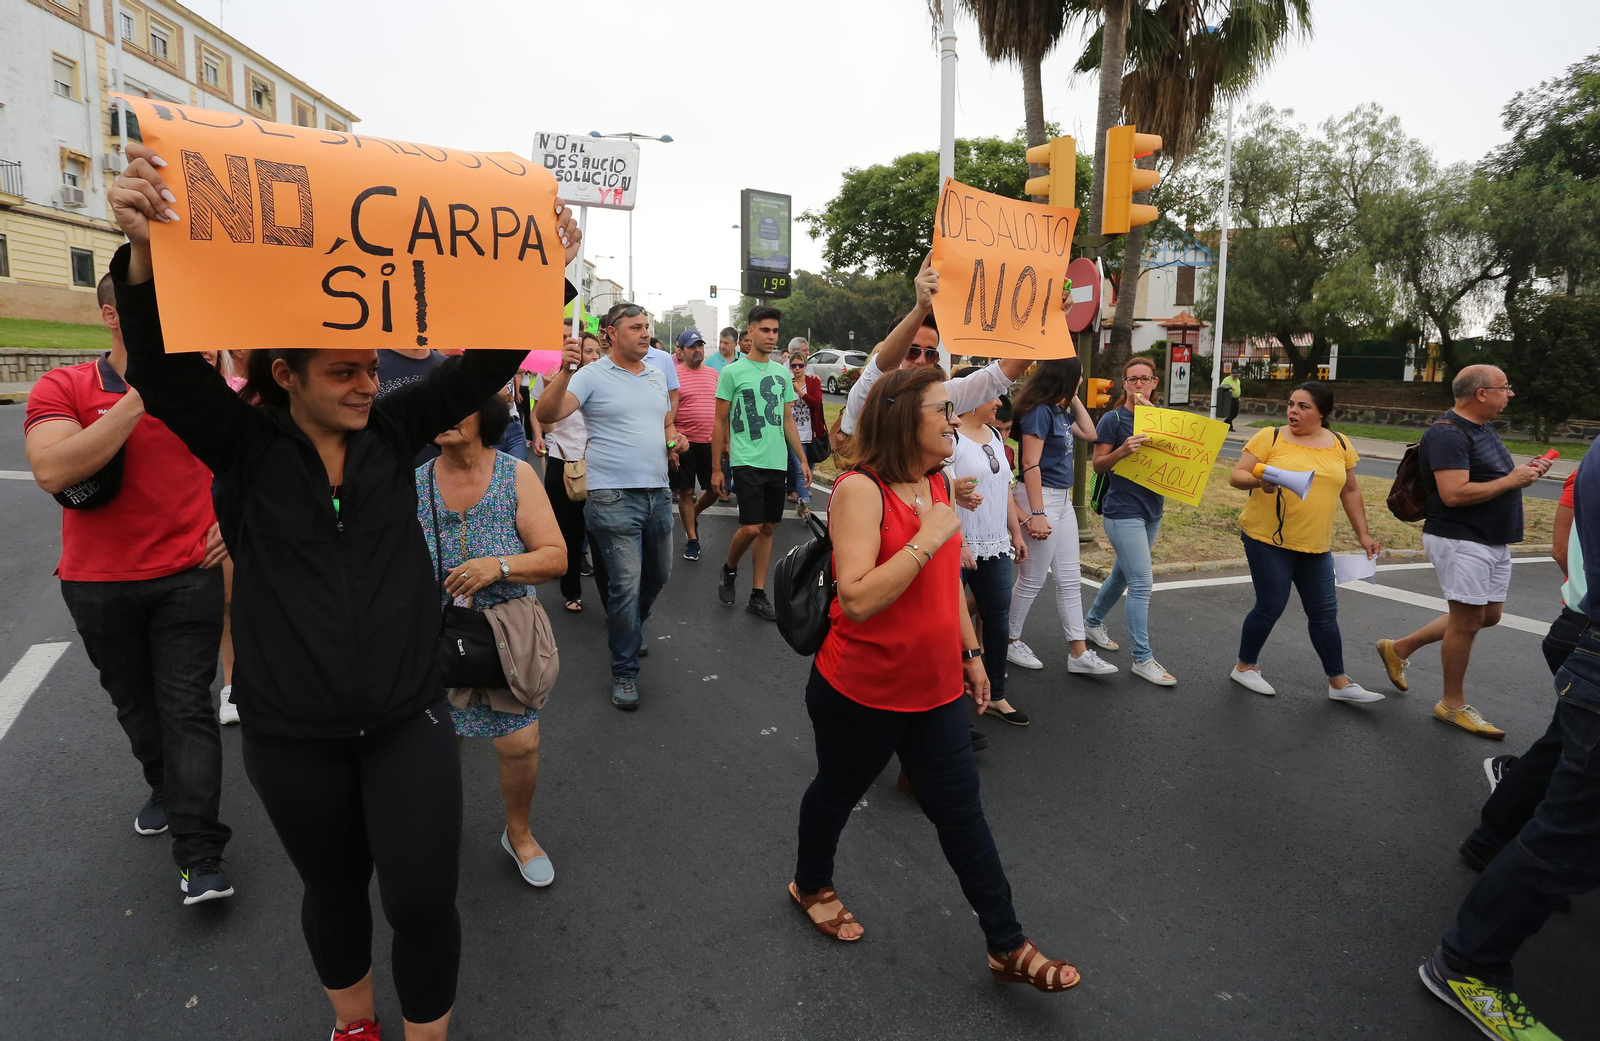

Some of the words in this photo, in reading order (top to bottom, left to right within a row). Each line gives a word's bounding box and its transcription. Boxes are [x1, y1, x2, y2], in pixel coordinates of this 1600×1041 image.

[570, 142, 585, 153] AL
[351, 186, 548, 265] CARPA
[964, 259, 1052, 335] NO!
[1155, 439, 1192, 456] CARPA
